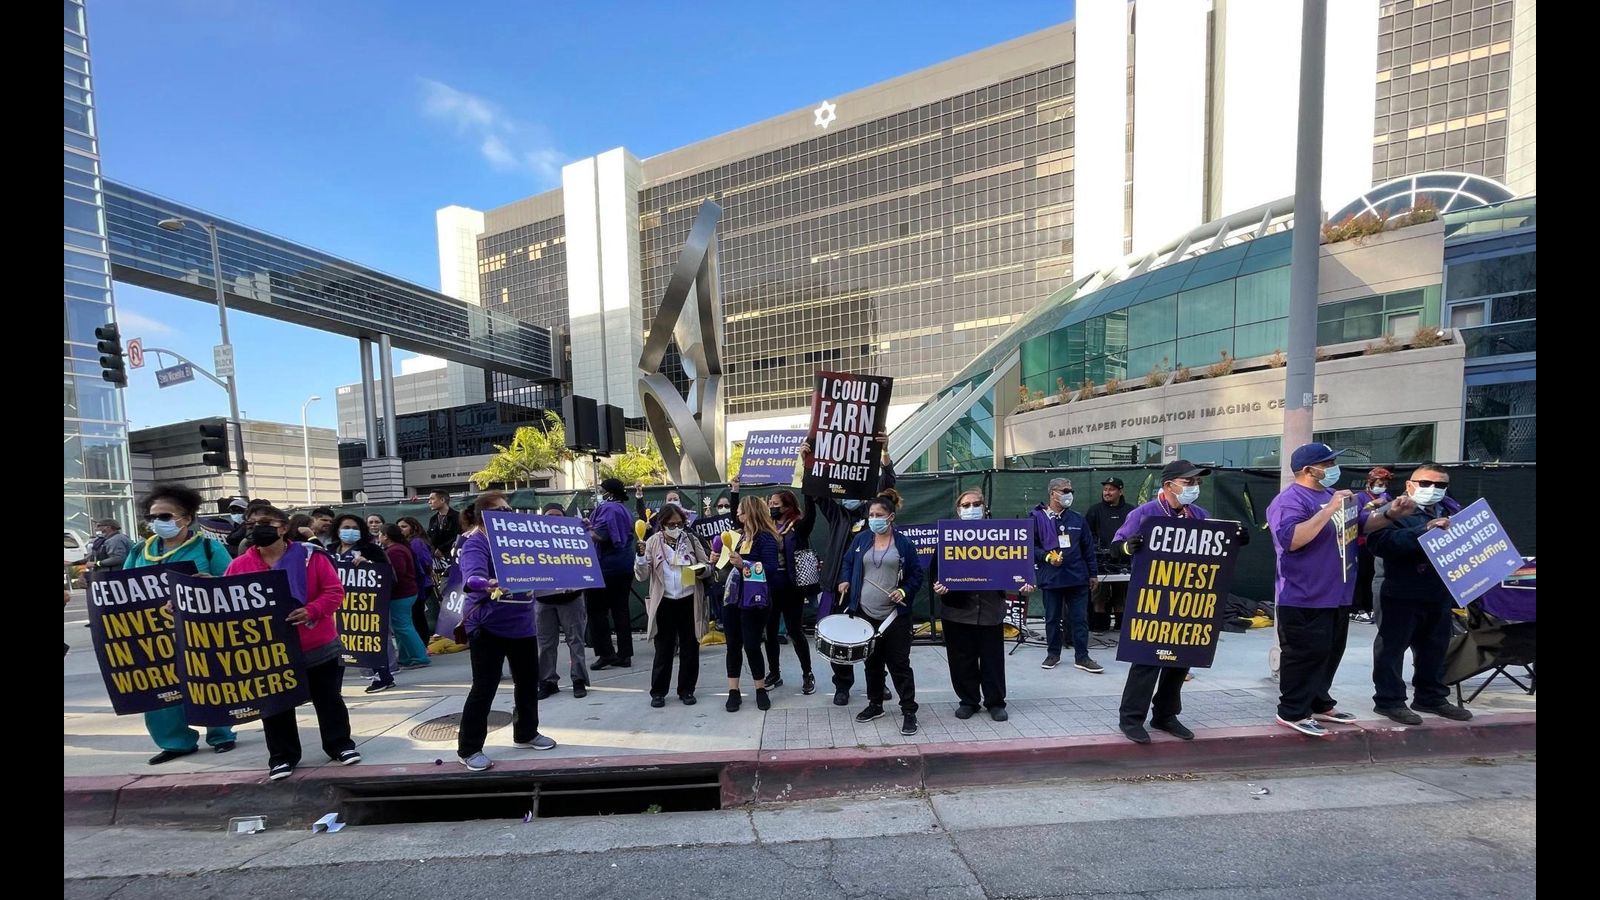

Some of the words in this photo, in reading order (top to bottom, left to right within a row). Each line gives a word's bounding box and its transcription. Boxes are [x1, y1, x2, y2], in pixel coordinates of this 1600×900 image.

[821, 378, 827, 398] I
[832, 379, 879, 403] COULD
[818, 400, 876, 434] EARN
[1059, 425, 1084, 437] MARK
[1086, 421, 1117, 433] TAPER
[1120, 410, 1196, 428] FOUNDATION
[1200, 402, 1261, 418] IMAGING
[1267, 393, 1328, 409] CEER
[745, 458, 765, 466] Safe
[747, 446, 779, 455] Heroes
[781, 446, 800, 455] NEE
[814, 431, 873, 464] MORE
[812, 461, 826, 477] AT
[828, 462, 870, 481] TARGET
[491, 518, 585, 536] Healthcare
[696, 518, 735, 538] CEDARS:
[920, 537, 938, 546] NEE
[944, 528, 1010, 541] ENOUGH
[1014, 528, 1028, 541] IS
[1149, 526, 1230, 556] CEDARS:
[1427, 509, 1490, 554] Healthcare
[496, 536, 550, 548] Heroes
[552, 538, 589, 550] NEED
[944, 545, 1028, 560] ENOUGH!
[1436, 540, 1473, 568] Heroes
[1470, 522, 1498, 546] NEED
[501, 552, 535, 564] Safe
[538, 553, 593, 568] Staffing
[1148, 560, 1220, 590] INVEST
[1447, 562, 1471, 582] Safe
[1468, 539, 1508, 568] Staffing
[91, 572, 170, 606] CEDARS
[338, 568, 382, 588] DARS:
[176, 582, 276, 614] CEDARS:
[1137, 588, 1162, 615] IN
[1168, 590, 1217, 619] YOUR
[102, 606, 175, 639] INVES
[184, 615, 273, 648] INVEST
[342, 612, 380, 632] YOUR
[1130, 618, 1213, 646] WORKERS
[104, 641, 135, 668] IN
[138, 634, 176, 662] YO
[340, 634, 382, 652] RKERS
[184, 650, 210, 678] IN
[216, 642, 290, 677] YOUR
[110, 662, 180, 694] WORK
[187, 669, 298, 706] WORKERS
